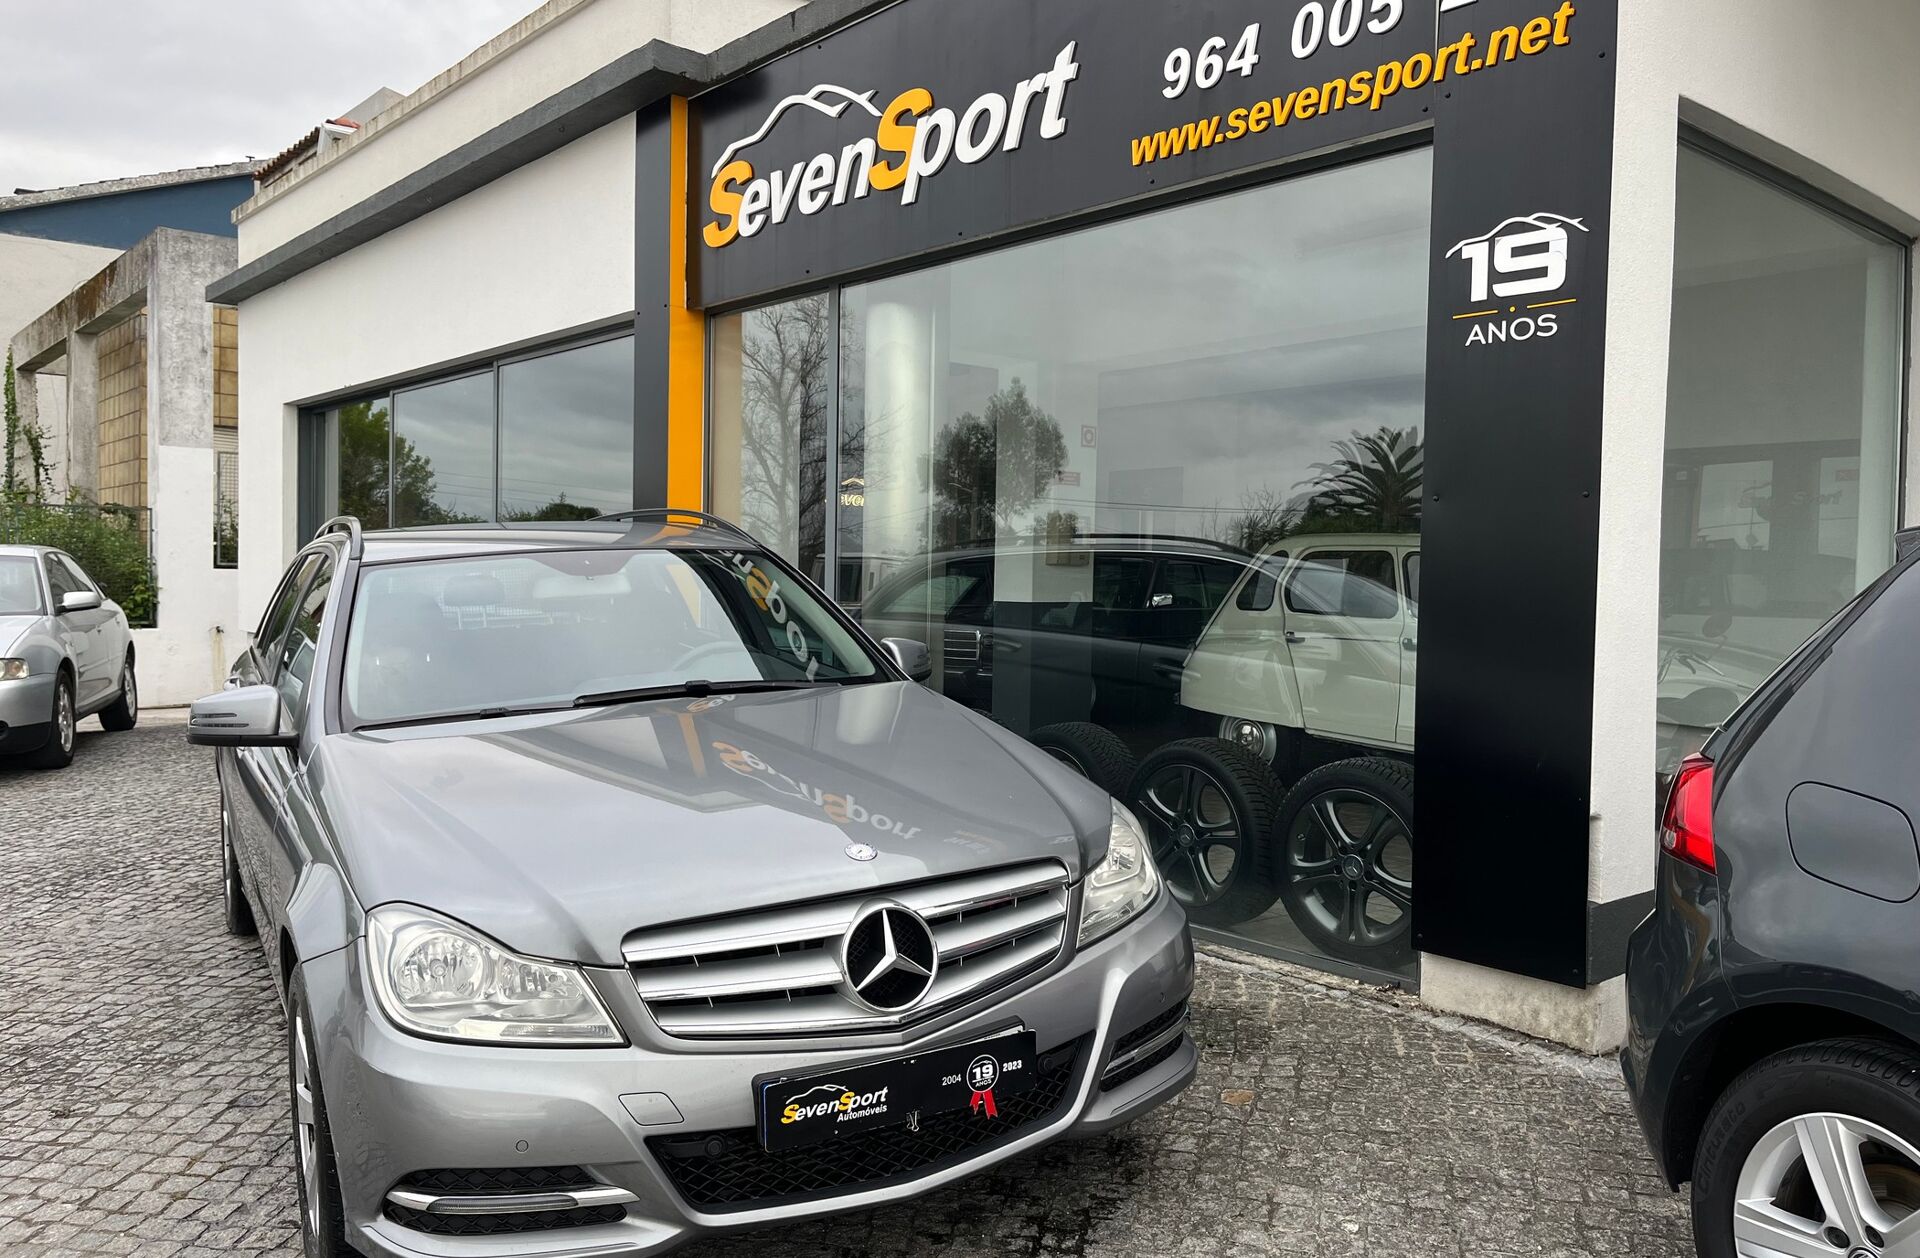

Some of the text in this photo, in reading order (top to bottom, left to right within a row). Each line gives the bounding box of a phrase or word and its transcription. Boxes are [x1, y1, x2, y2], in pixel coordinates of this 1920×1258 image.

[1131, 1, 1575, 166] www.sevensport.net
[1162, 22, 1260, 99] 964
[702, 40, 1080, 248] SevenSport
[1461, 226, 1568, 302] 19
[1464, 313, 1558, 347] ANOS
[941, 1060, 1022, 1086] 2004 19 2023
[780, 1086, 889, 1124] SevenSport
[836, 1103, 888, 1123] Automóveis
